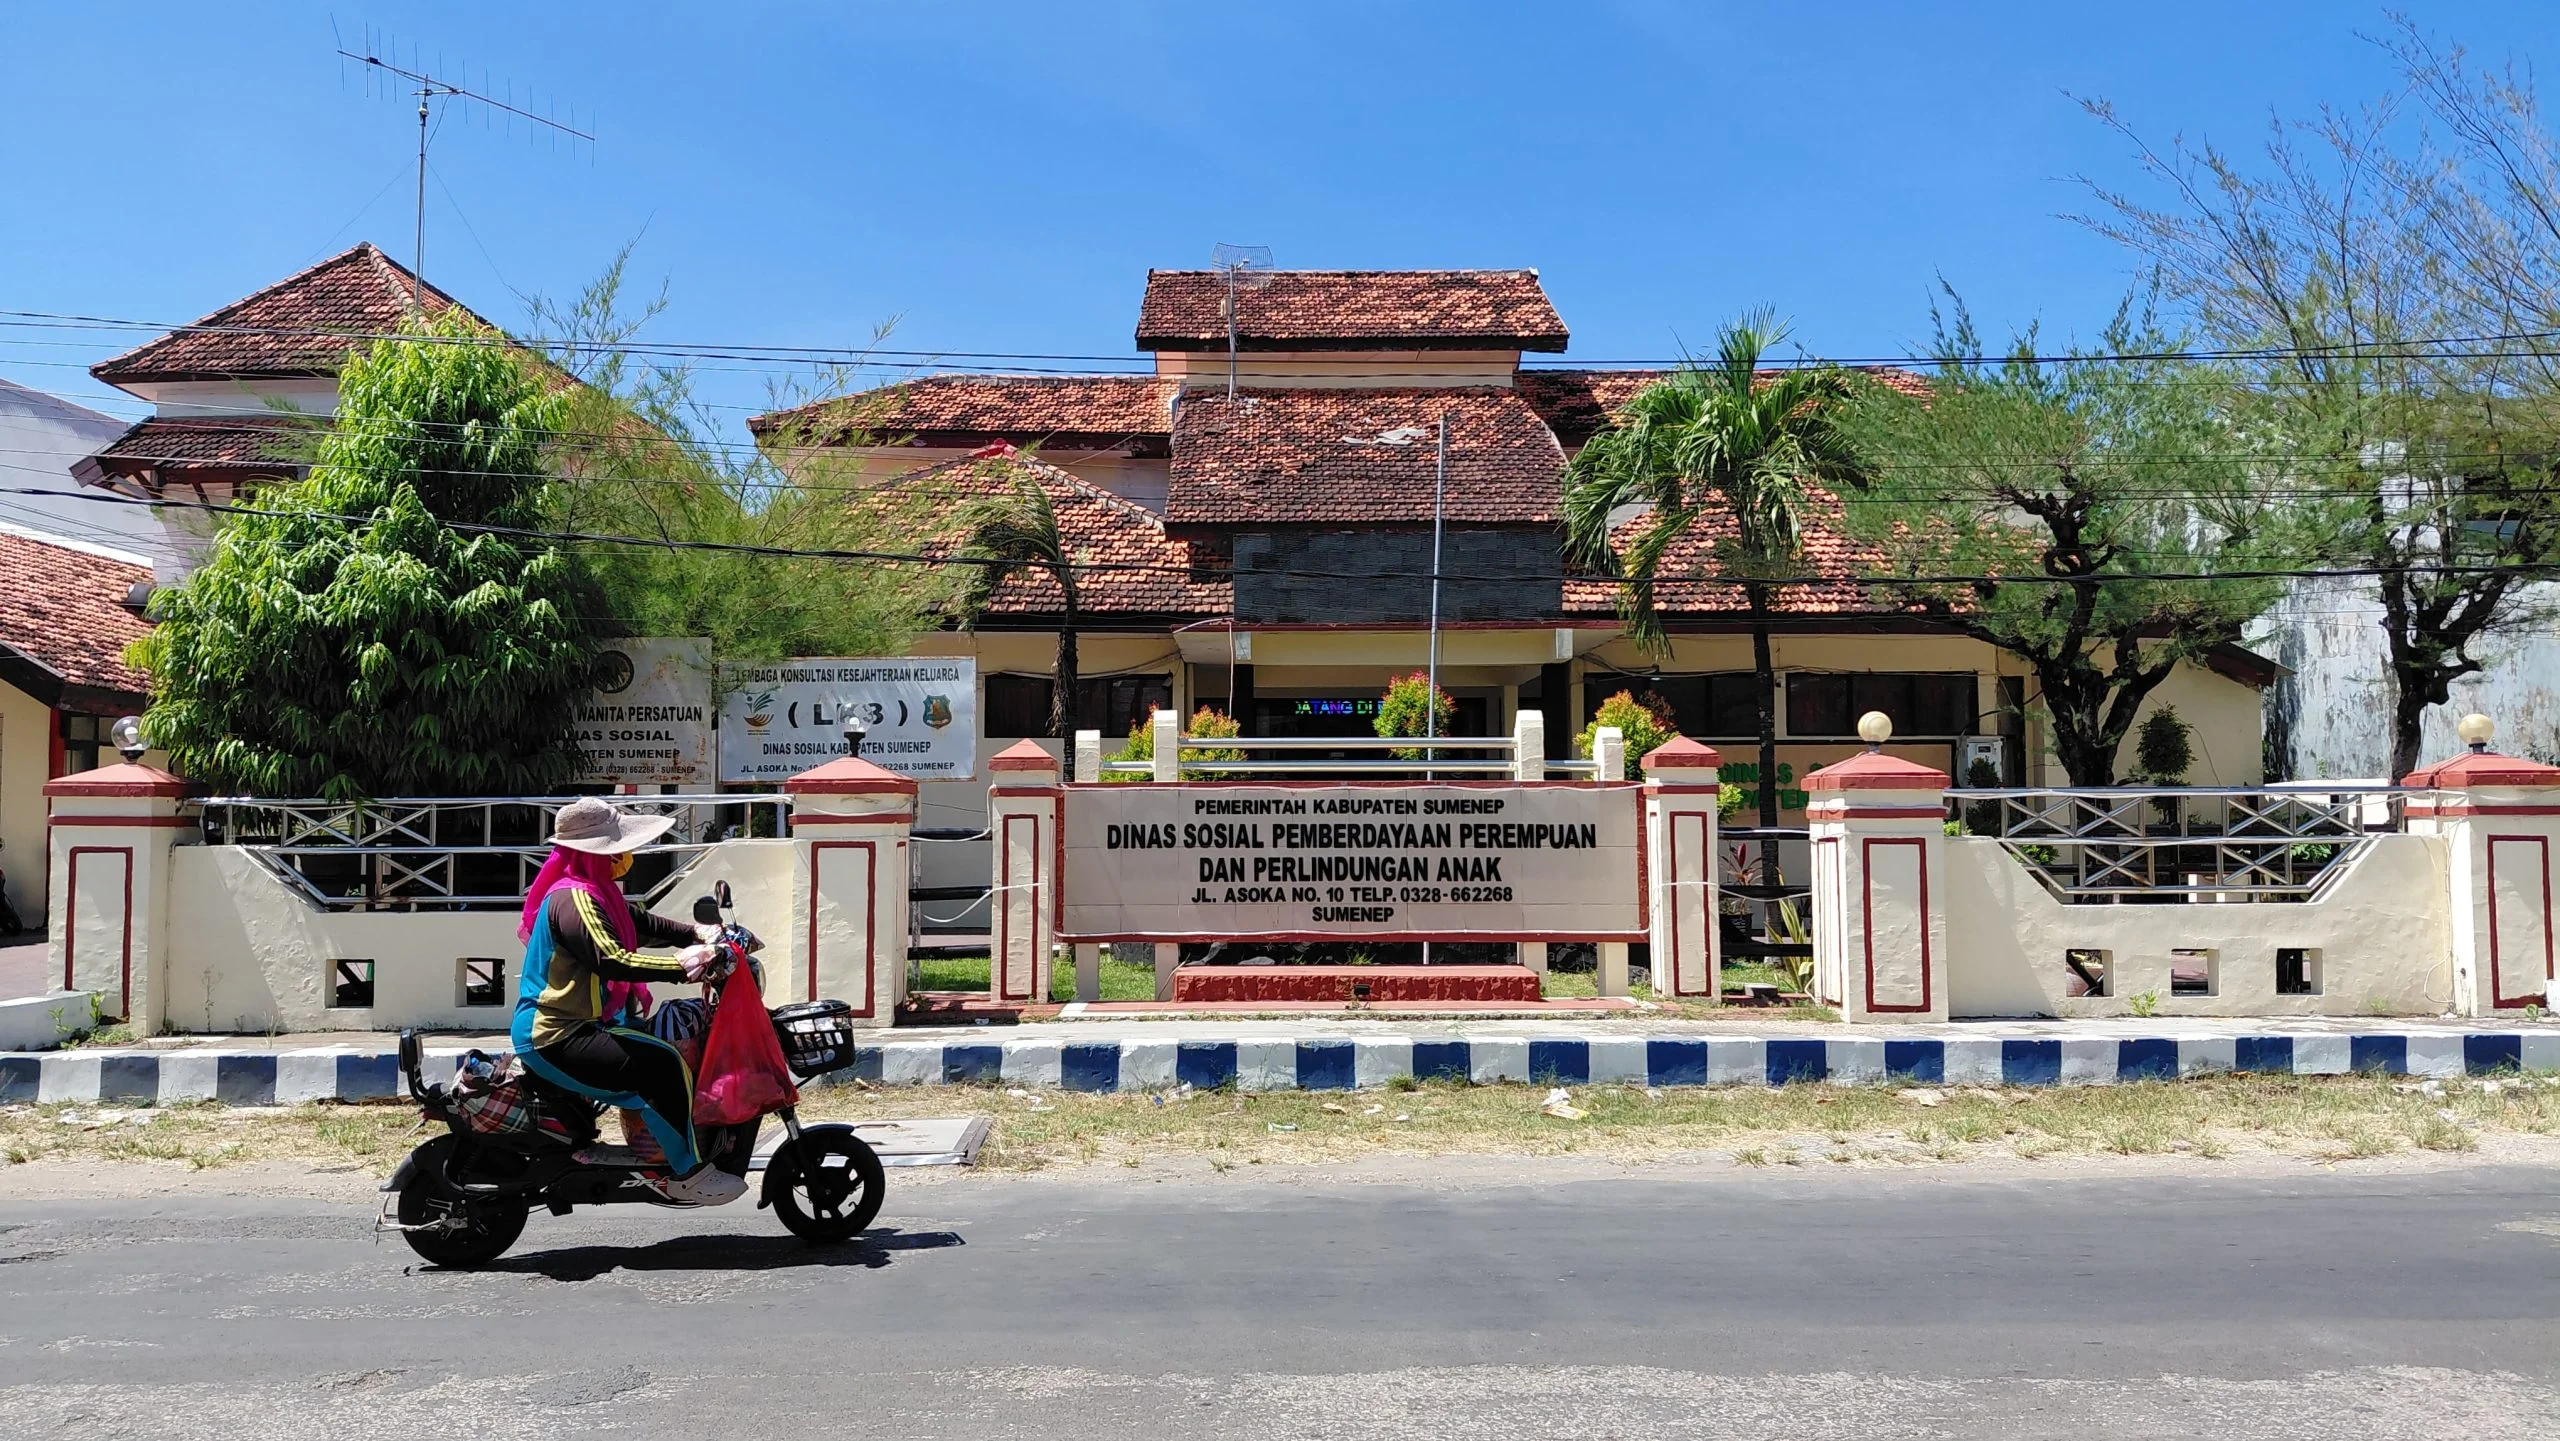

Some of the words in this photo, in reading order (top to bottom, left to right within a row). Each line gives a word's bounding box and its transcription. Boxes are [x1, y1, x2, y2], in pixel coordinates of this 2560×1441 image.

[780, 668, 835, 682] KONSULTASI
[838, 668, 911, 682] KESEJAHTERAAN
[913, 667, 960, 682] KELUARGA
[577, 706, 625, 722] WANITA
[628, 706, 702, 722] PERSATUAN
[1357, 701, 1373, 714] DI
[609, 730, 675, 741] SOSIAL
[618, 749, 680, 759] SUMENEP
[763, 743, 791, 755] DINAS
[794, 743, 827, 755] SOSIAL
[830, 742, 885, 755] KABPATEN
[887, 741, 931, 754] SUMENEP
[629, 766, 655, 774] 662268
[661, 766, 696, 774] SUMENEP
[741, 765, 754, 773] JL.
[757, 765, 788, 773] ASOKA
[912, 762, 955, 771] SUMENEP
[1195, 800, 1306, 815] PEMERINTAH
[1313, 800, 1417, 814] KABUPATEN
[1423, 799, 1504, 814] SUMENEP
[1107, 824, 1177, 849] DINAS
[1183, 824, 1264, 849] SOSIAL
[1272, 824, 1451, 849] PEMBERDAYAAN
[1459, 823, 1596, 849] PEREMPUAN
[1200, 857, 1245, 882] DAN
[1254, 856, 1428, 882] PERLINDUNGAN
[1436, 856, 1502, 882] ANAK
[1192, 888, 1217, 903] JL.
[1224, 887, 1286, 902] ASOKA
[1292, 887, 1320, 902] NO.
[1326, 887, 1344, 902] 10
[1350, 887, 1397, 902] TELP.
[1312, 907, 1394, 922] SUMENEP
